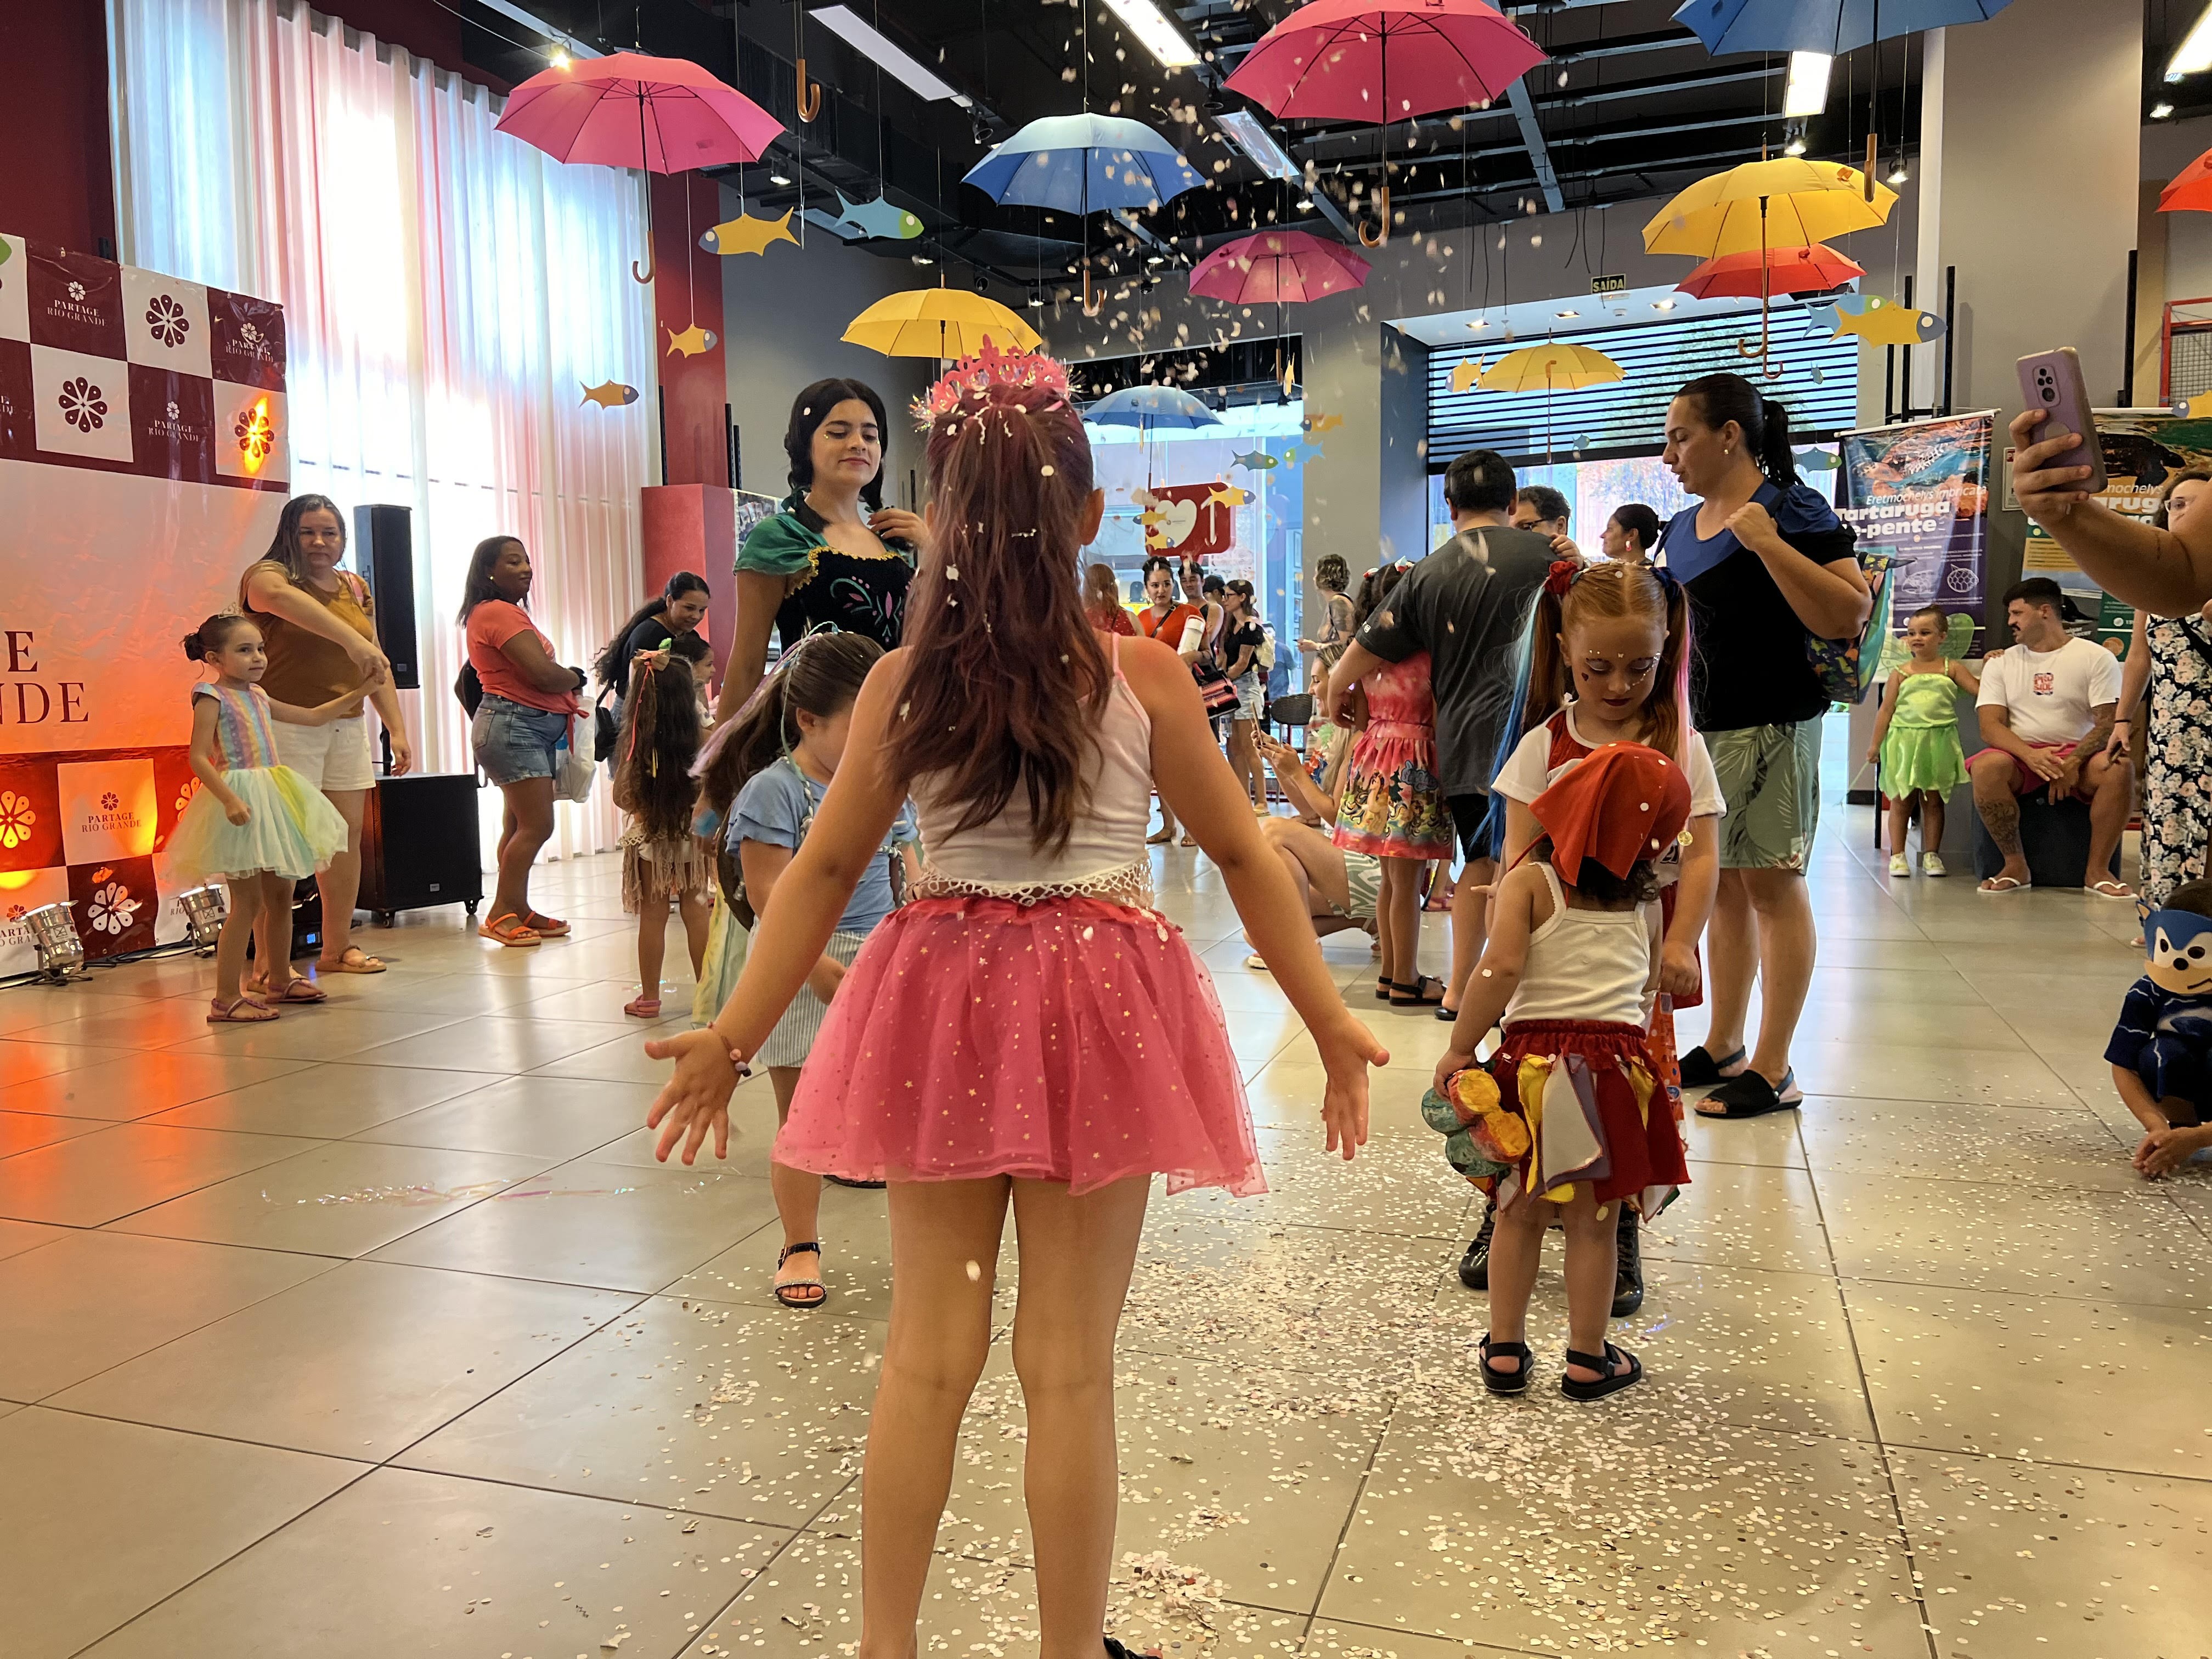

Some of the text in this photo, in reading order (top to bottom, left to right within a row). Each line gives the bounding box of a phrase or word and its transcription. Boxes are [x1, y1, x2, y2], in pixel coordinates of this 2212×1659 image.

[1593, 277, 1624, 292] SAÍDA
[47, 307, 106, 326] RIO GRANDE
[54, 300, 99, 317] PARTAGE
[148, 427, 165, 436] RIO
[1866, 489, 1934, 505] Eretmochelys
[1835, 500, 1951, 521] Tartaruga
[1843, 518, 1937, 539] e-pente
[82, 819, 142, 832] RIO GRANDE
[88, 812, 134, 823] PARTAGE
